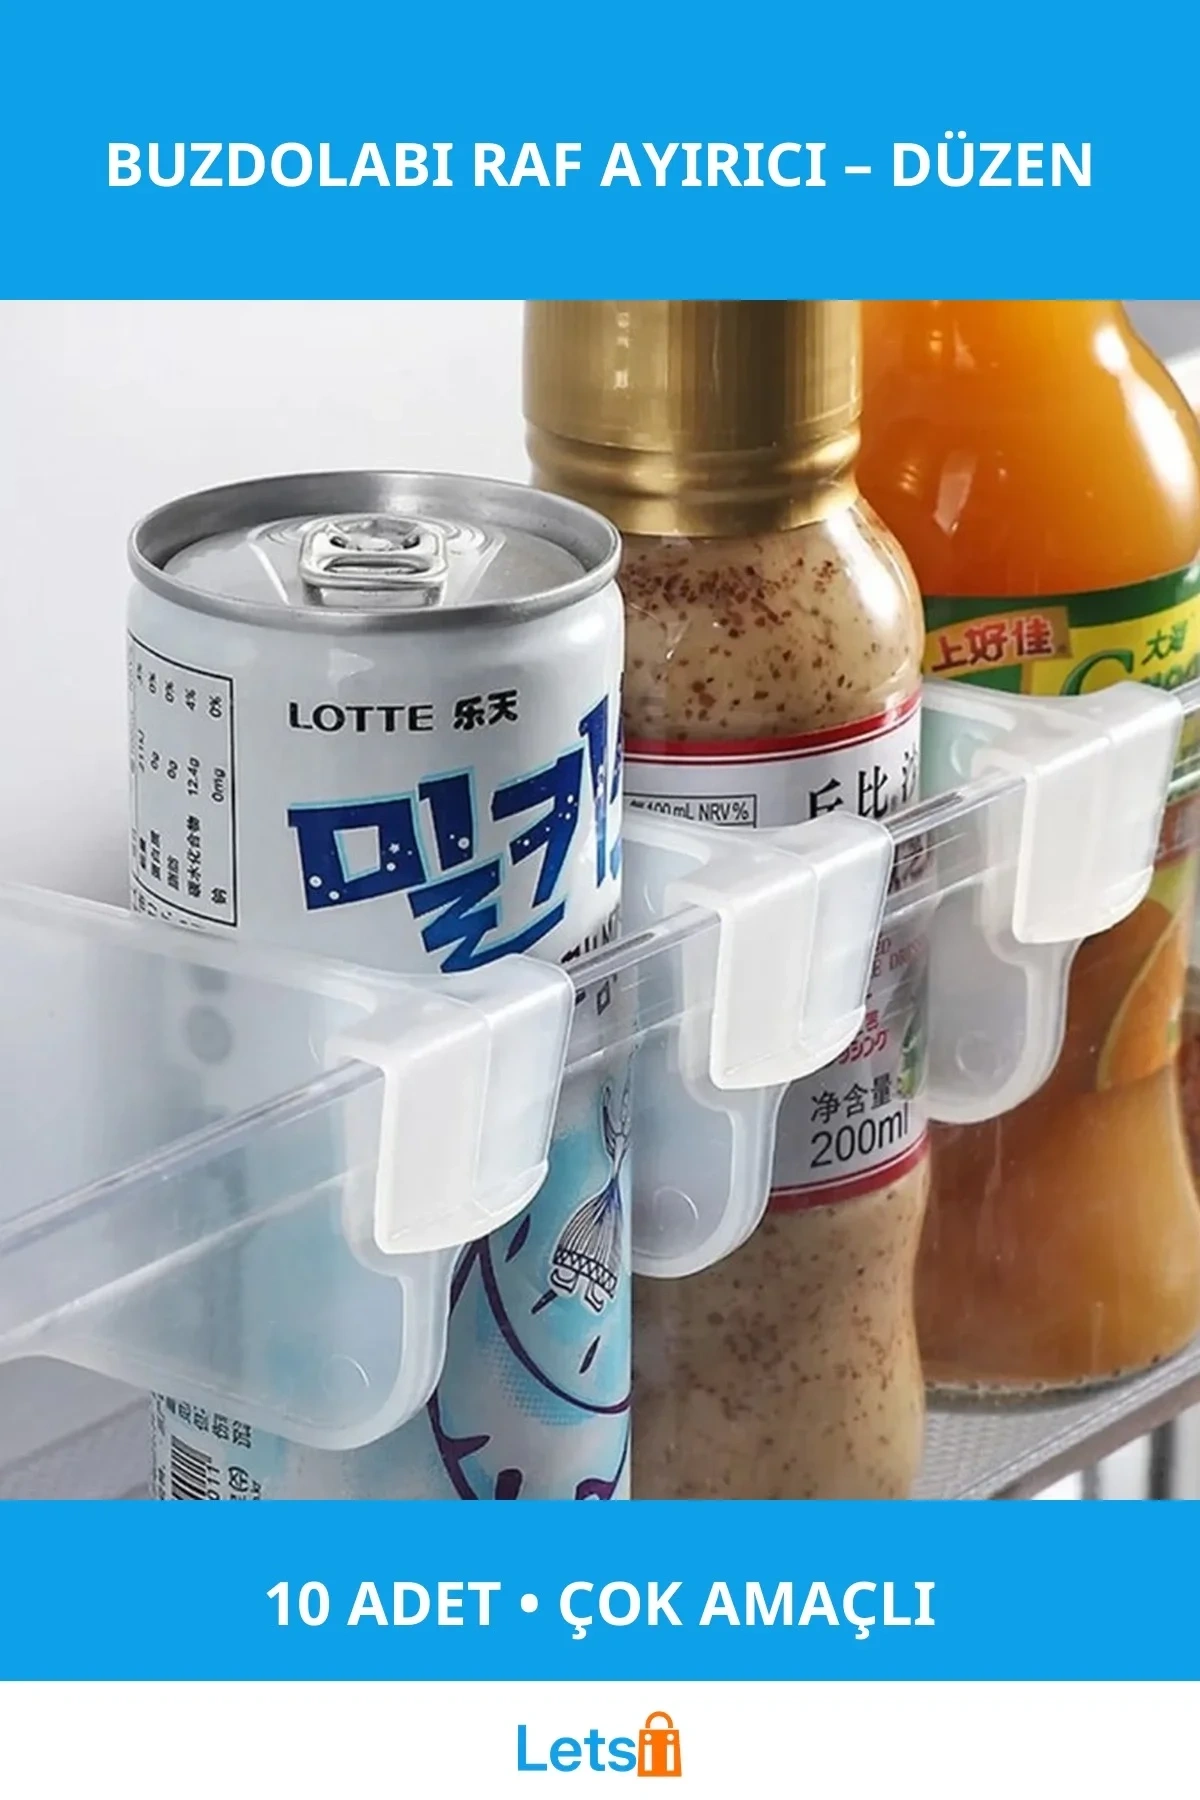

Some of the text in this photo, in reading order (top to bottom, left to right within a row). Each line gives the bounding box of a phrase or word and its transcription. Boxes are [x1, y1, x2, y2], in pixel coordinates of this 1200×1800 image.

[931, 616, 1053, 672] 上好佳
[208, 694, 223, 719] 0%
[289, 689, 518, 733] LOTTE 乐天
[210, 767, 227, 803] 0mg
[810, 1072, 892, 1126] 净含量
[809, 1102, 910, 1169] 200ml
